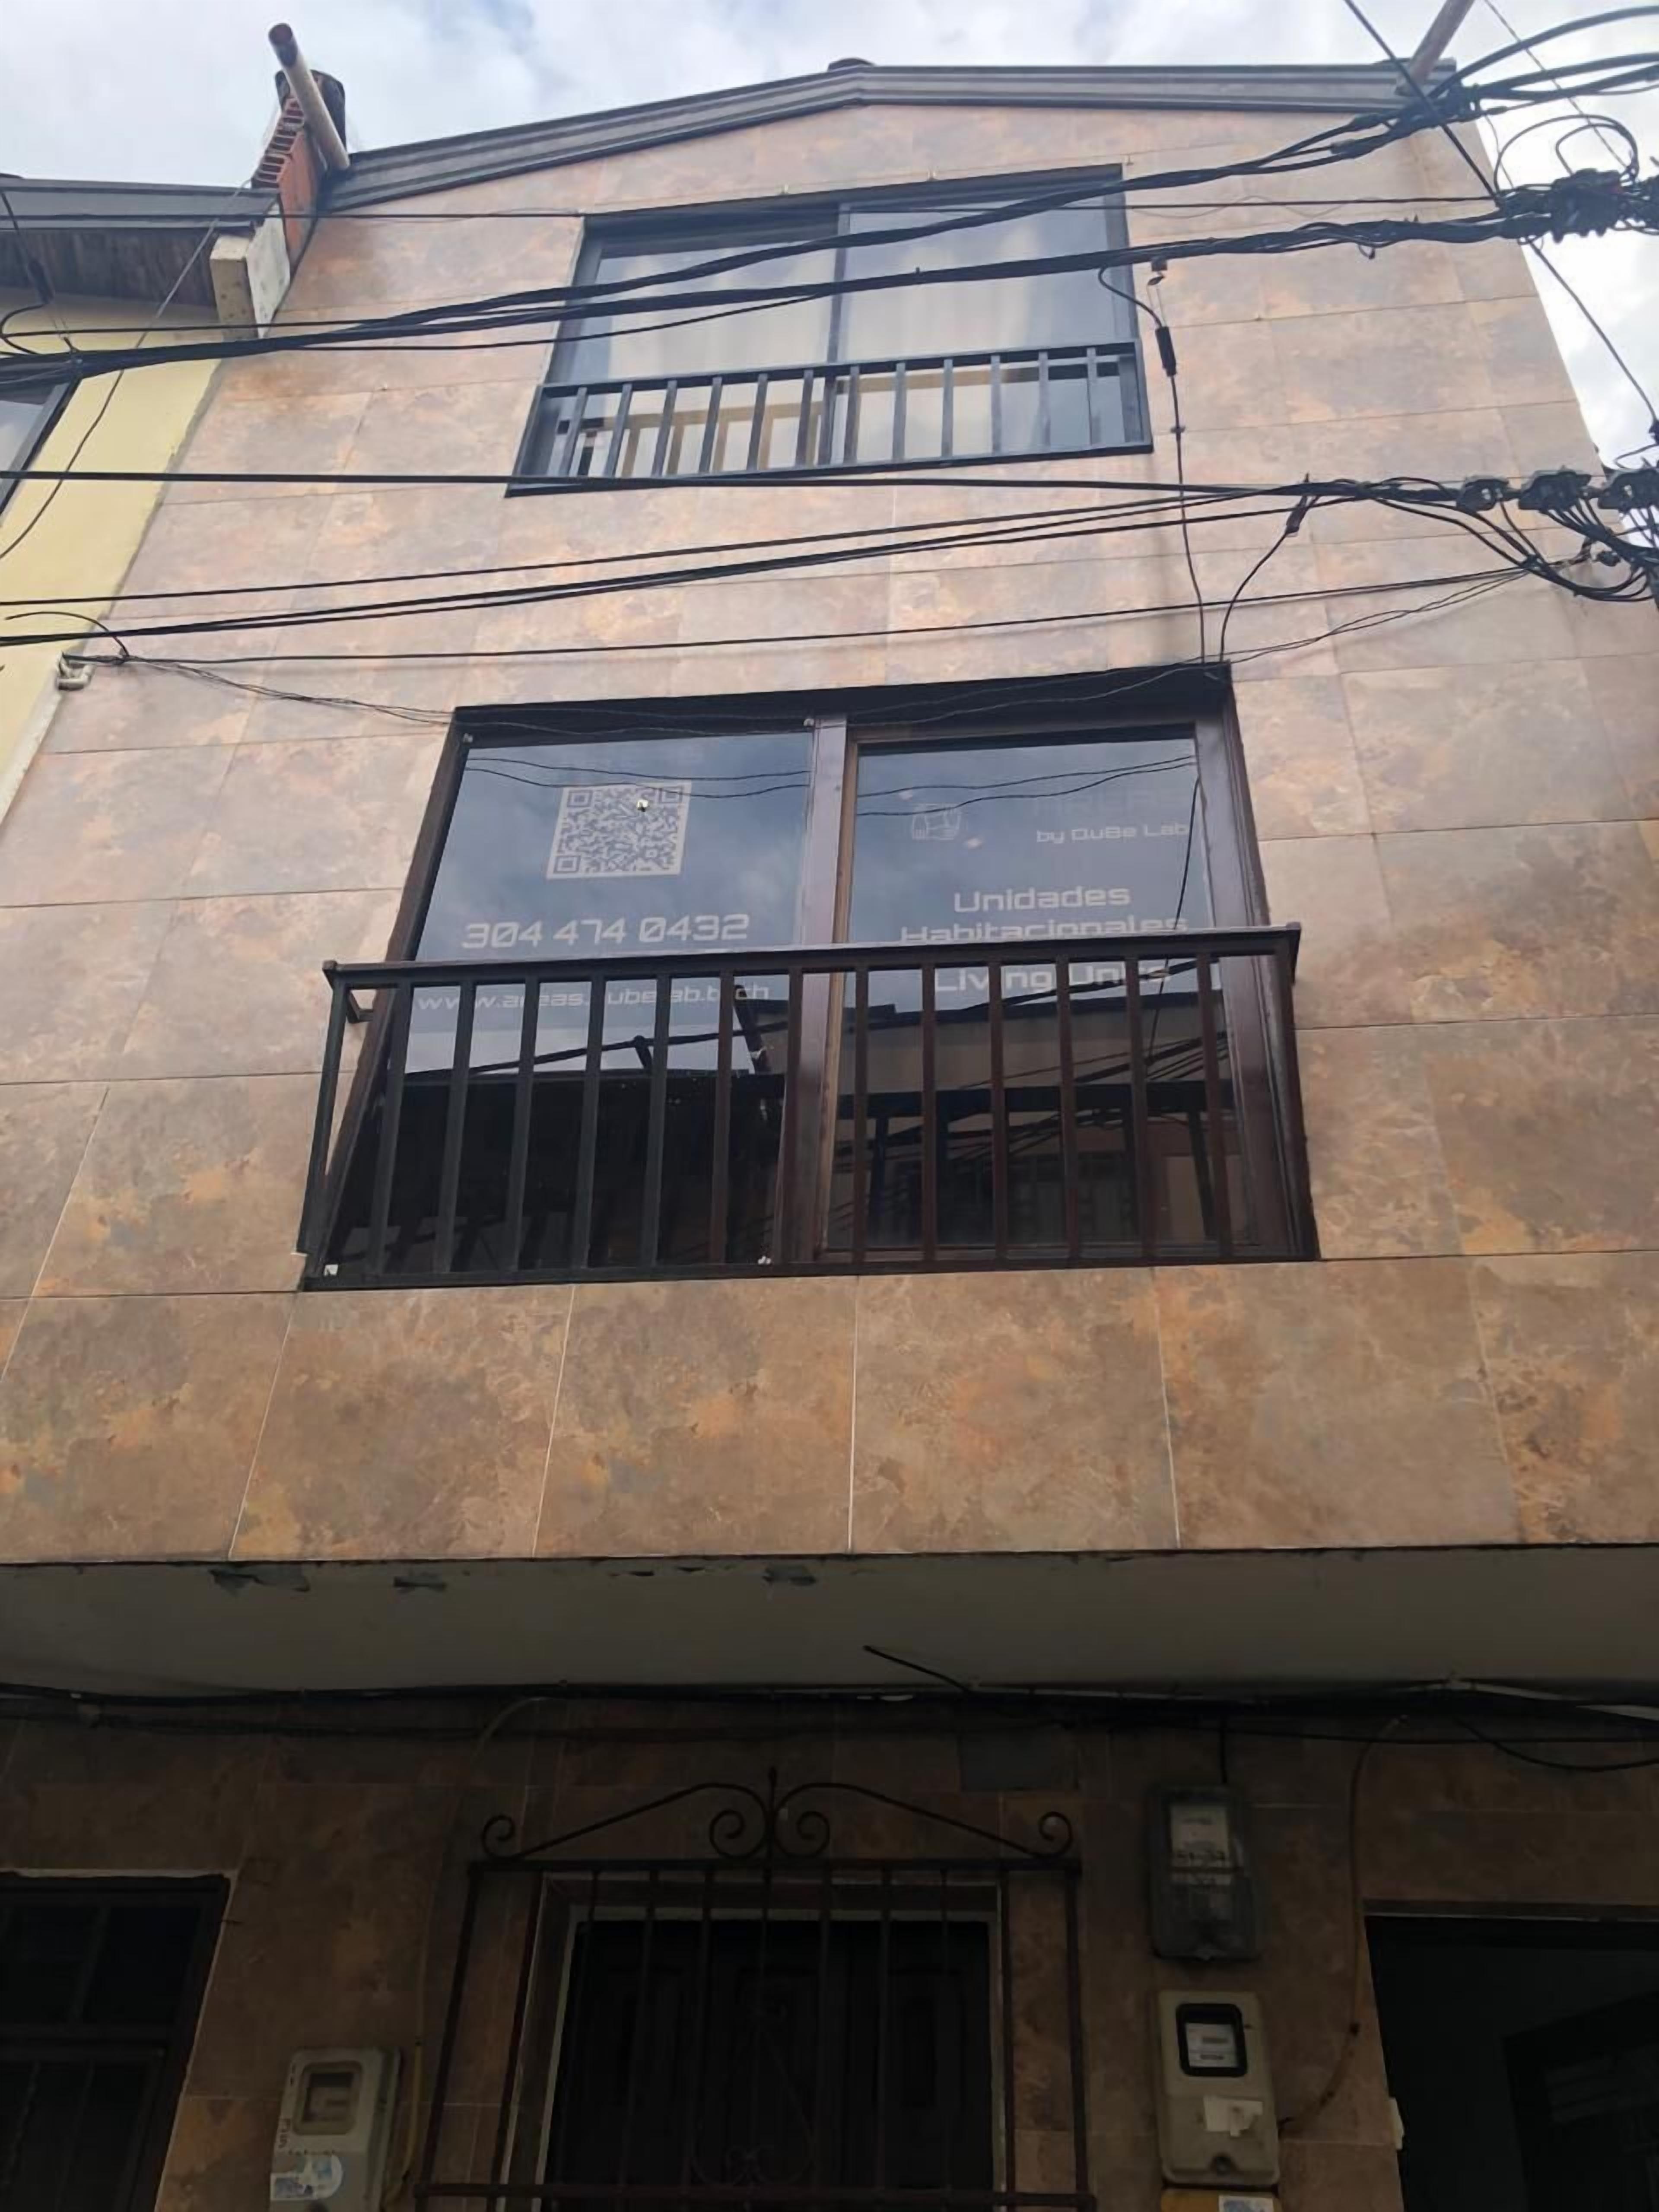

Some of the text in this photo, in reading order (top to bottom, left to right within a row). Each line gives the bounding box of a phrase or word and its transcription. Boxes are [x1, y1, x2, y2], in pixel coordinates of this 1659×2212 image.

[1036, 829, 1065, 843] by
[1144, 822, 1189, 837] Lab
[954, 886, 1131, 913] Unidades
[461, 913, 750, 949] 304 474 0432
[899, 914, 1189, 945] Habitacionales
[934, 966, 1053, 993] Livng
